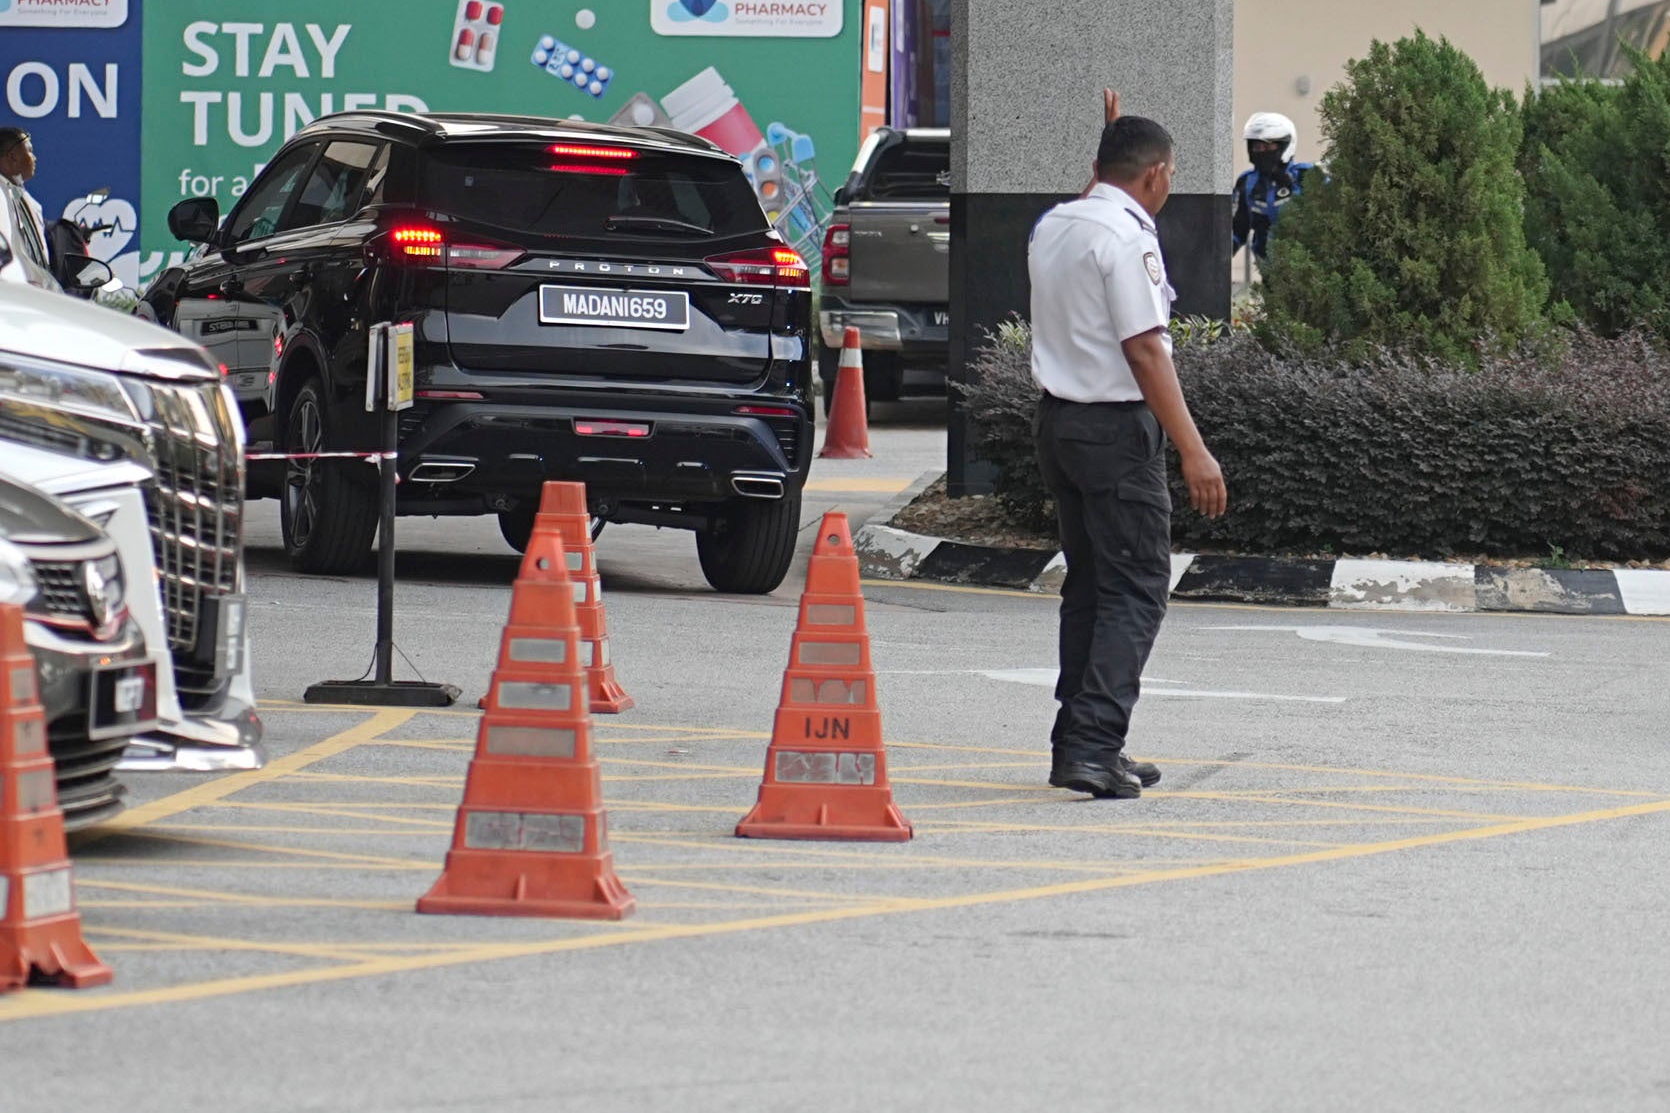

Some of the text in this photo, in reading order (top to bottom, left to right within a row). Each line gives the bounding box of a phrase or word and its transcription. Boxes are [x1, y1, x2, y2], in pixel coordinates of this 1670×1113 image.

[734, 2, 828, 16] PHARMACY
[182, 21, 352, 78] STAY
[6, 61, 119, 119] ON
[178, 168, 224, 197] for
[549, 261, 684, 275] PROTON
[563, 293, 667, 319] MADANI659
[804, 717, 850, 740] IJN
